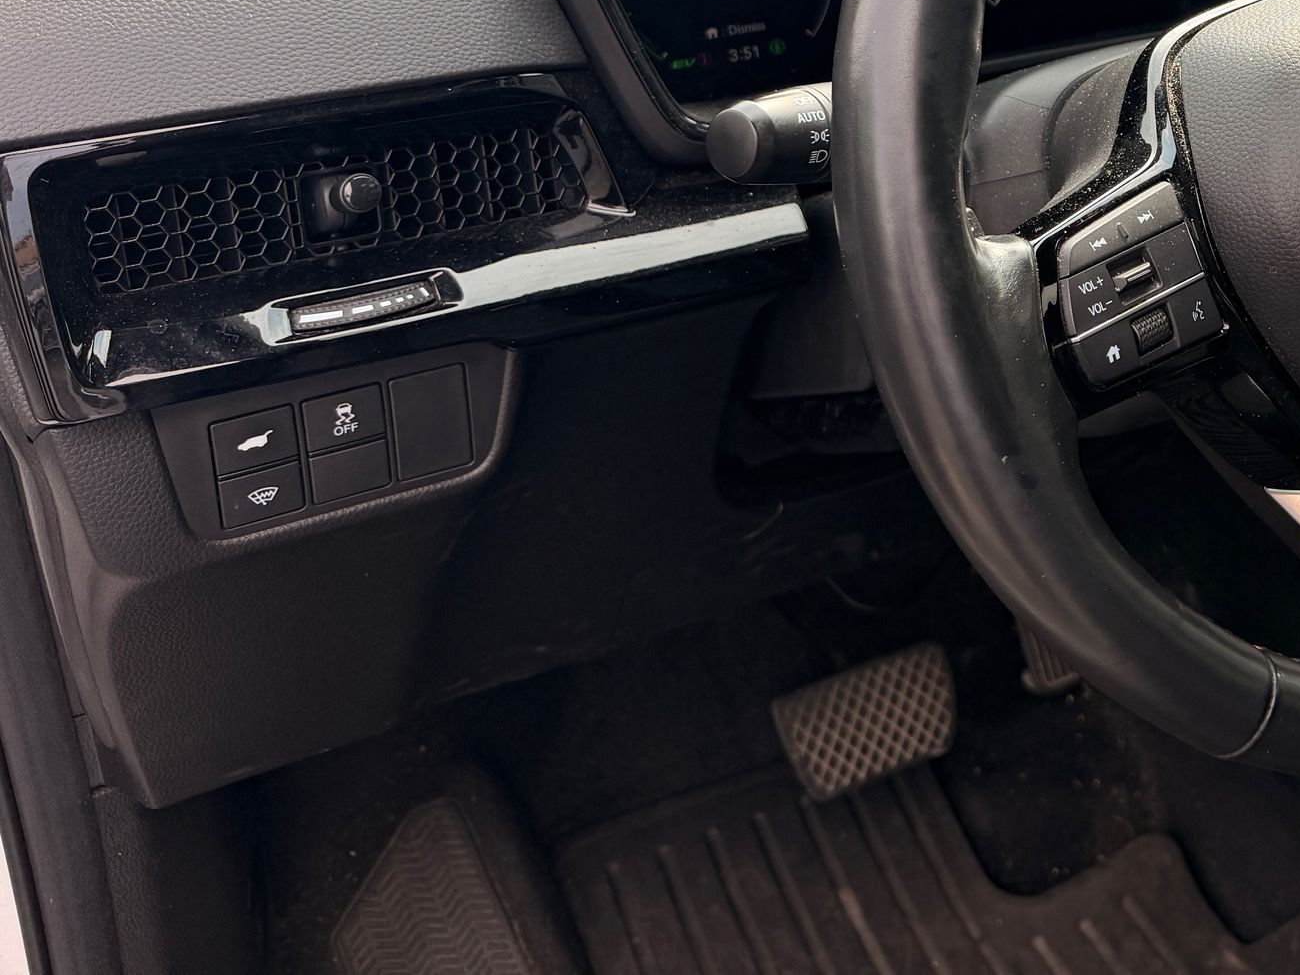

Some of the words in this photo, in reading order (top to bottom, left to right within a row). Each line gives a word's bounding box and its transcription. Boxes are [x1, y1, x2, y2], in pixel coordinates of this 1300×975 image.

[727, 21, 767, 36] Dismiss
[728, 45, 760, 63] 3:51
[797, 110, 826, 124] AUTO
[333, 421, 359, 437] OFF
